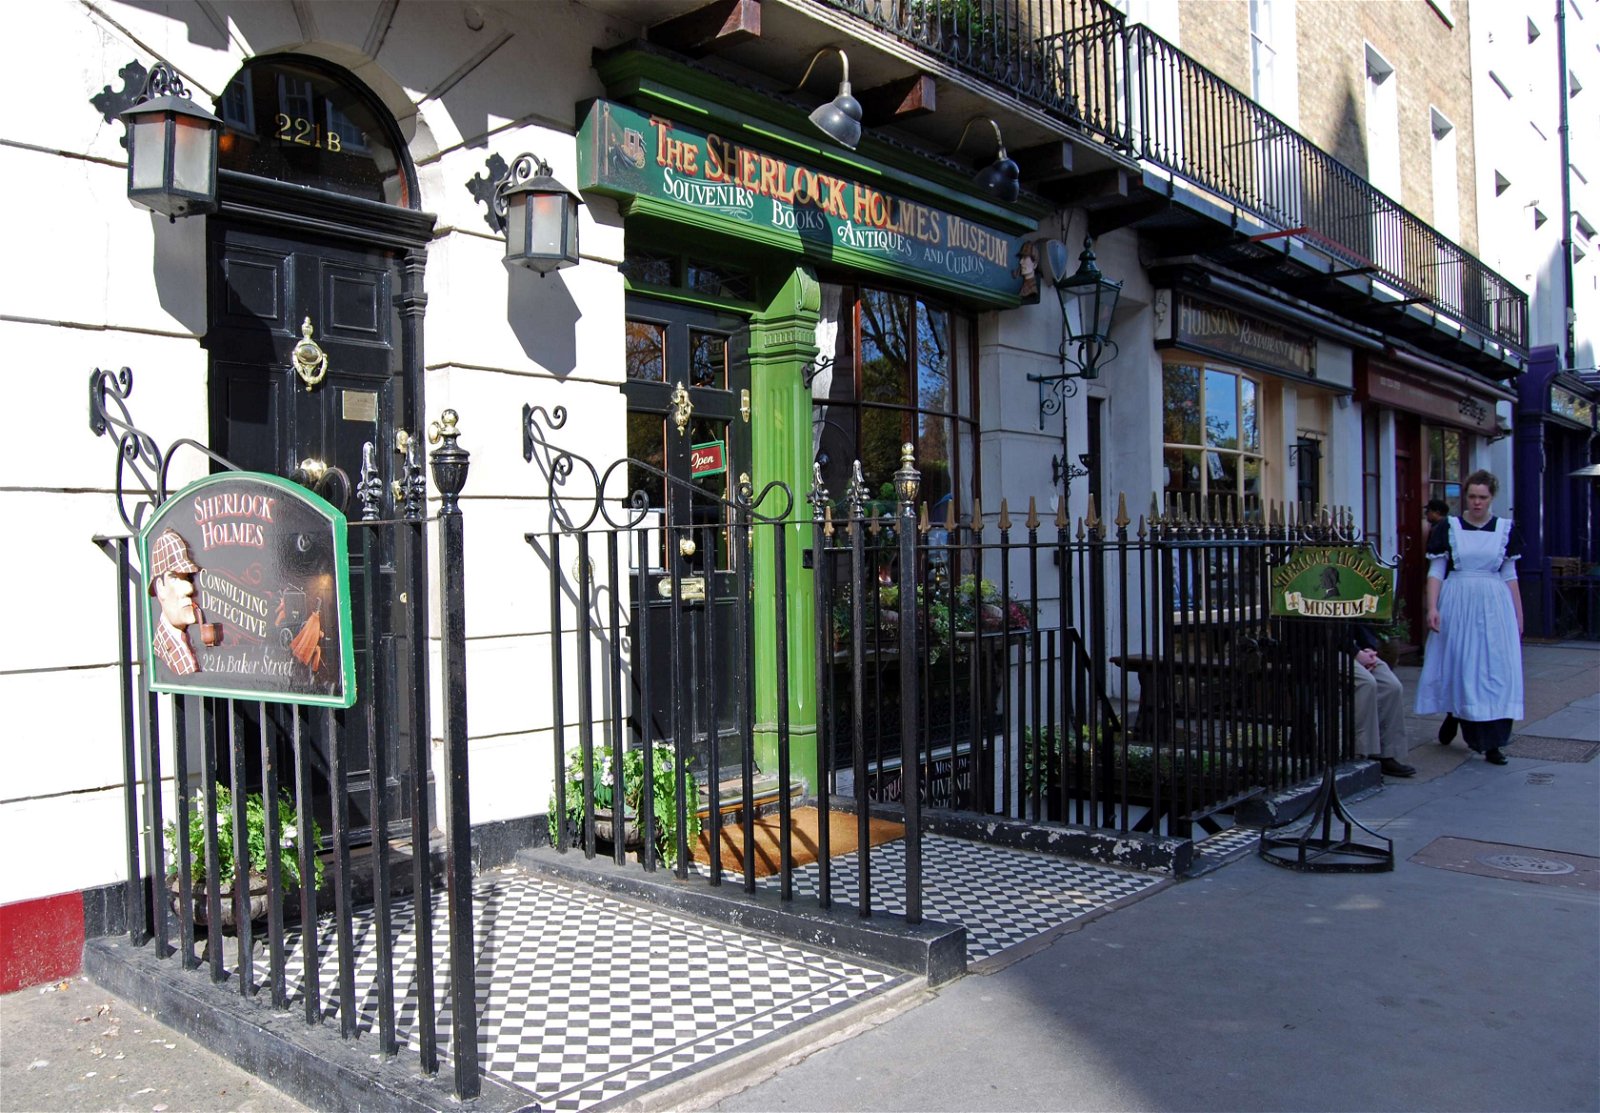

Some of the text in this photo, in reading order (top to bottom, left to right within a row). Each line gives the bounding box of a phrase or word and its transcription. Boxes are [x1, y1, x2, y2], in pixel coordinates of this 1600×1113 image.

[275, 113, 341, 152] 221B
[649, 115, 1008, 267] THE SHERLOCK HOLMES MUSEUM
[663, 167, 985, 276] SOUVENIRS BOOKS ANTIQUES AND CURIOS
[1180, 295, 1240, 336] HUDSONS
[691, 452, 714, 469] Open
[194, 493, 275, 523] SHERLOCK
[201, 521, 265, 549] HOLMES
[199, 568, 269, 618] CONSULTING
[1272, 550, 1392, 597] SHERLOCK HOLMES
[202, 590, 267, 638] DETECTIVE
[1303, 599, 1365, 616] MUSEUM
[226, 652, 260, 674] Baker
[261, 653, 295, 677] Street
